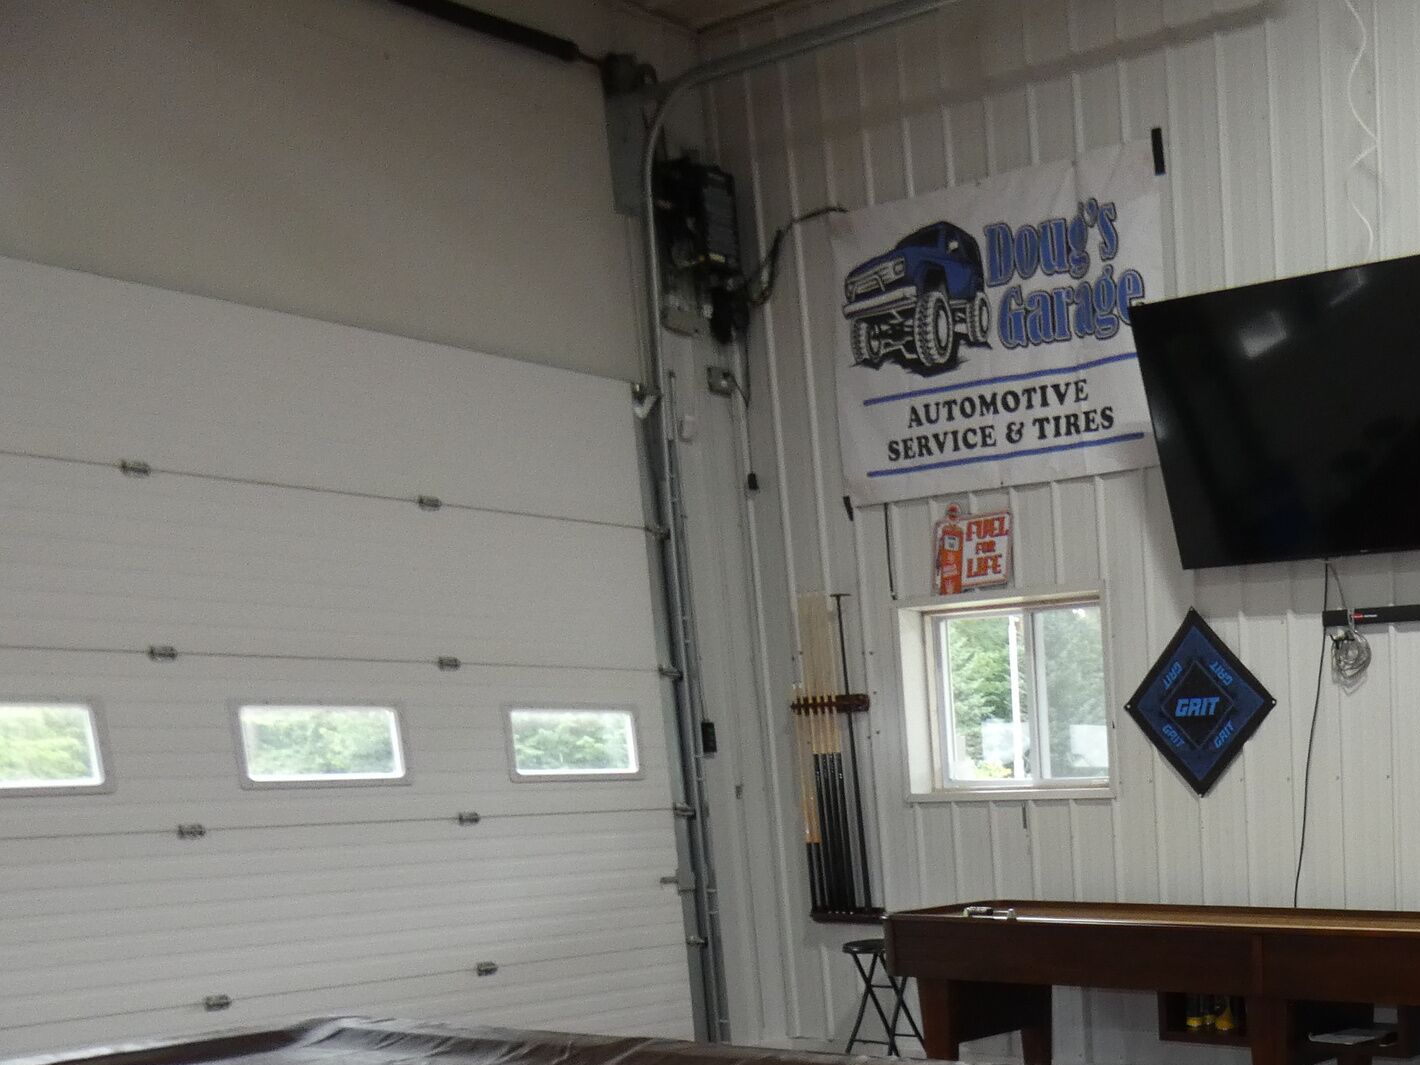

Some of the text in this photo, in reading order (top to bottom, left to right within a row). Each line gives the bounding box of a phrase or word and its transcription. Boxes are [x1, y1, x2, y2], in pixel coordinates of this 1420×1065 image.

[983, 197, 1119, 287] Doug's
[999, 263, 1145, 350] Garage
[907, 378, 1089, 428] AUTOMOTIVE
[887, 406, 1114, 462] SERVICE & TIRES
[1174, 697, 1220, 718] GRIT
[1214, 719, 1235, 749] GRIT
